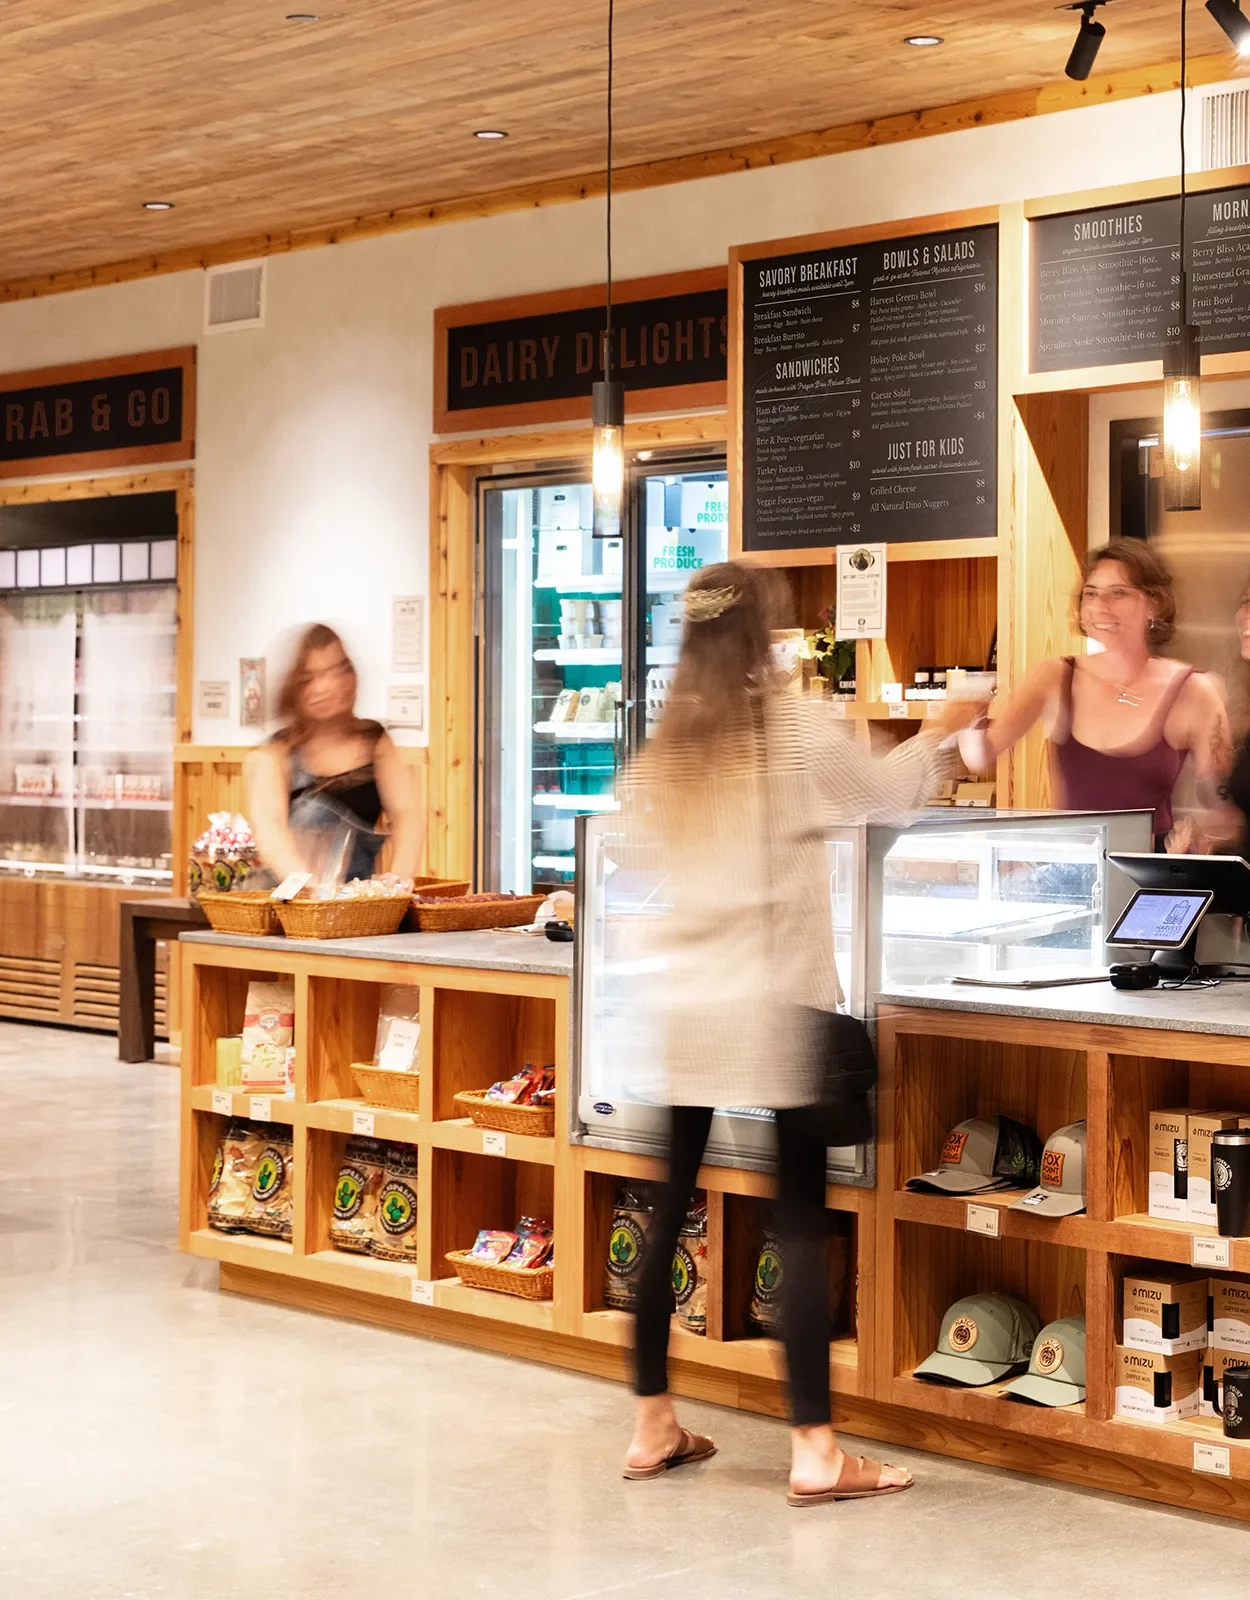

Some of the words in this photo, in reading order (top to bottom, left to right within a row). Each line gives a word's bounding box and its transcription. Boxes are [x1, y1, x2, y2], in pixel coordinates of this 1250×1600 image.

[1074, 215, 1142, 241] SMOOTHIES
[884, 248, 918, 271] BOWLS
[924, 248, 929, 264] &
[934, 240, 974, 262] SALADS
[760, 266, 796, 287] SAVORY
[801, 258, 857, 282] BREAKFAST
[1193, 268, 1235, 283] Homestead
[870, 297, 894, 306] Harvest
[895, 291, 919, 304] Greens
[920, 289, 936, 299] Bowl
[974, 283, 985, 292] $16
[1193, 298, 1211, 307] Fruit
[1214, 294, 1232, 305] Bowl
[461, 336, 559, 388] DAIRY
[776, 356, 839, 379] SANDWICHES
[6, 398, 73, 441] RAB
[92, 394, 110, 432] &
[128, 388, 169, 427] GO
[888, 442, 911, 460] JUST
[916, 440, 935, 457] FOR
[940, 437, 964, 455] KIDS
[870, 486, 892, 495] Grilled
[894, 485, 916, 493] Cheese
[977, 479, 985, 487] $8
[654, 557, 703, 569] PRODUCE
[663, 546, 695, 557] FRESH
[1044, 1153, 1060, 1166] FOX
